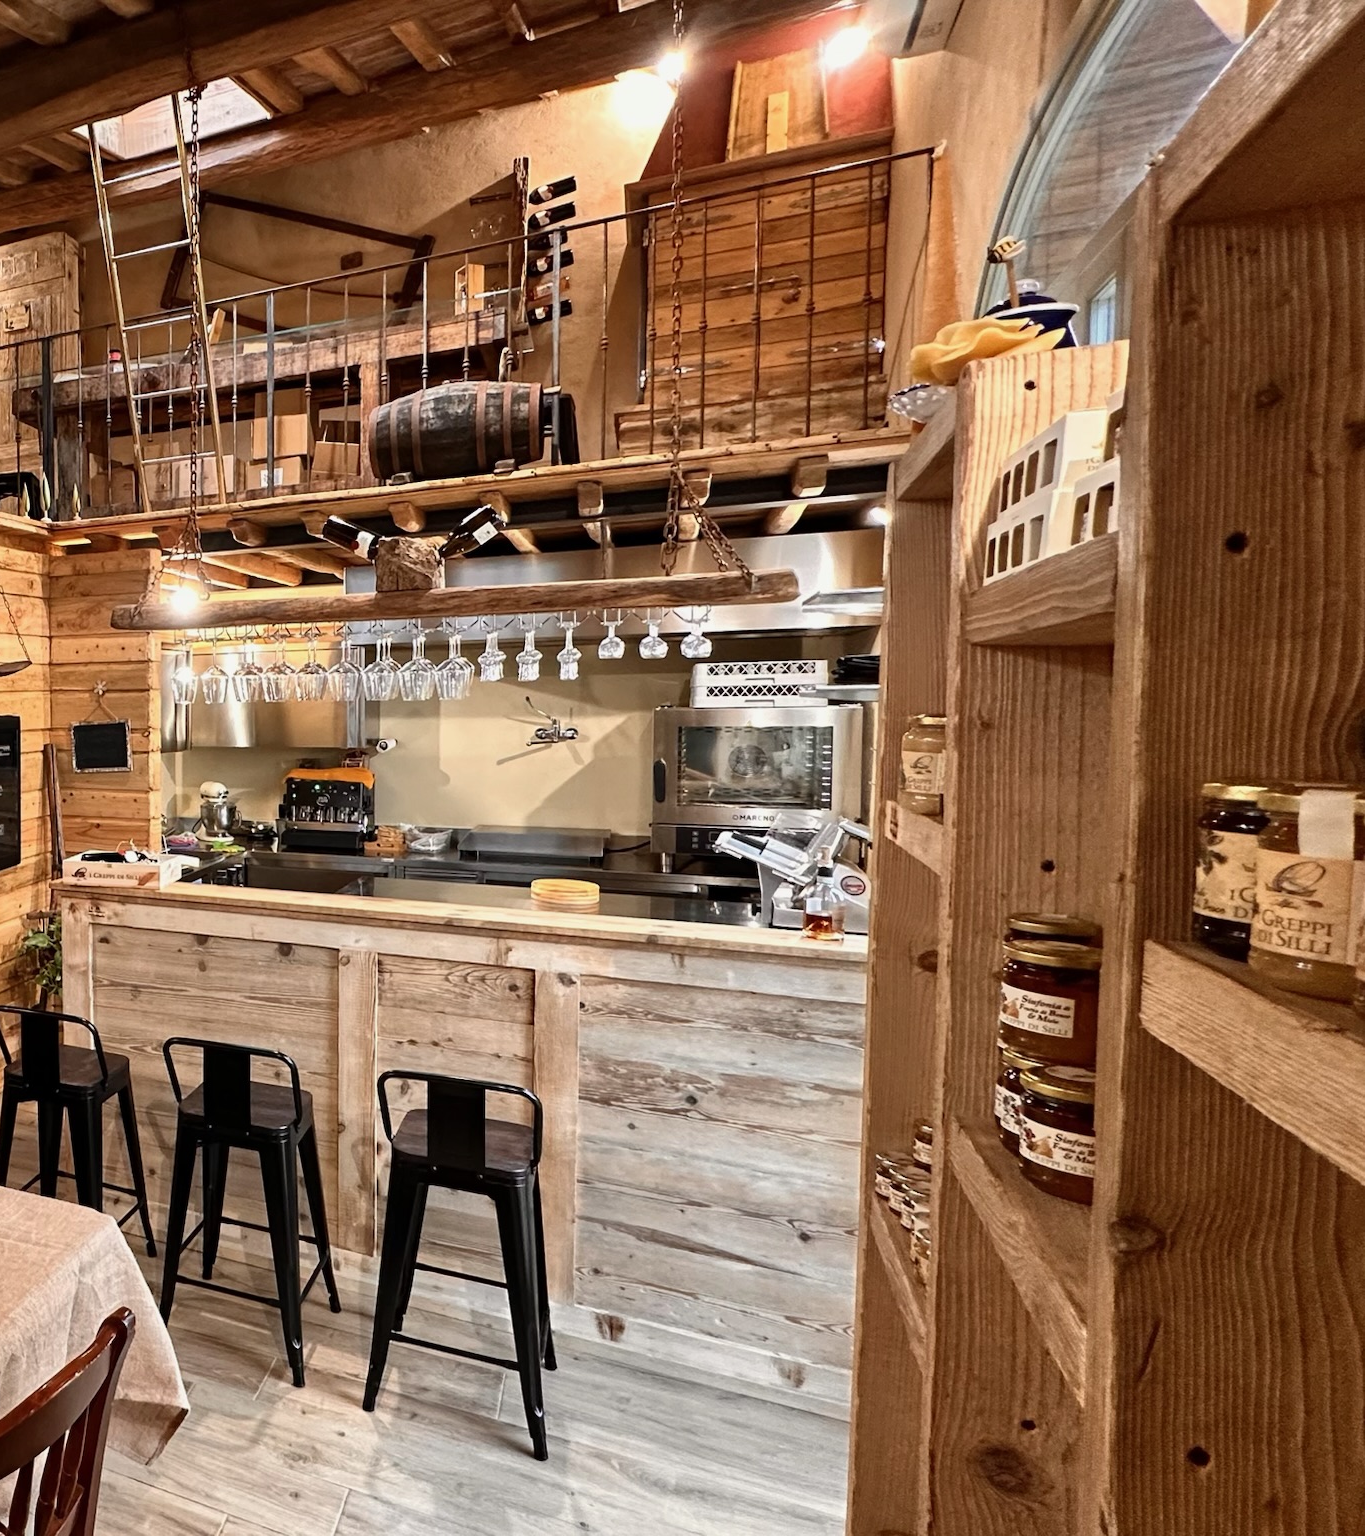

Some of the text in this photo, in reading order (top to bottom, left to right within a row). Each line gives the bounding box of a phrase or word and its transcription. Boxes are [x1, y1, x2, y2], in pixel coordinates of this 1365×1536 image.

[1261, 909, 1334, 938] GREPPI
[1257, 929, 1273, 945] DI
[1275, 930, 1332, 956] SILLI
